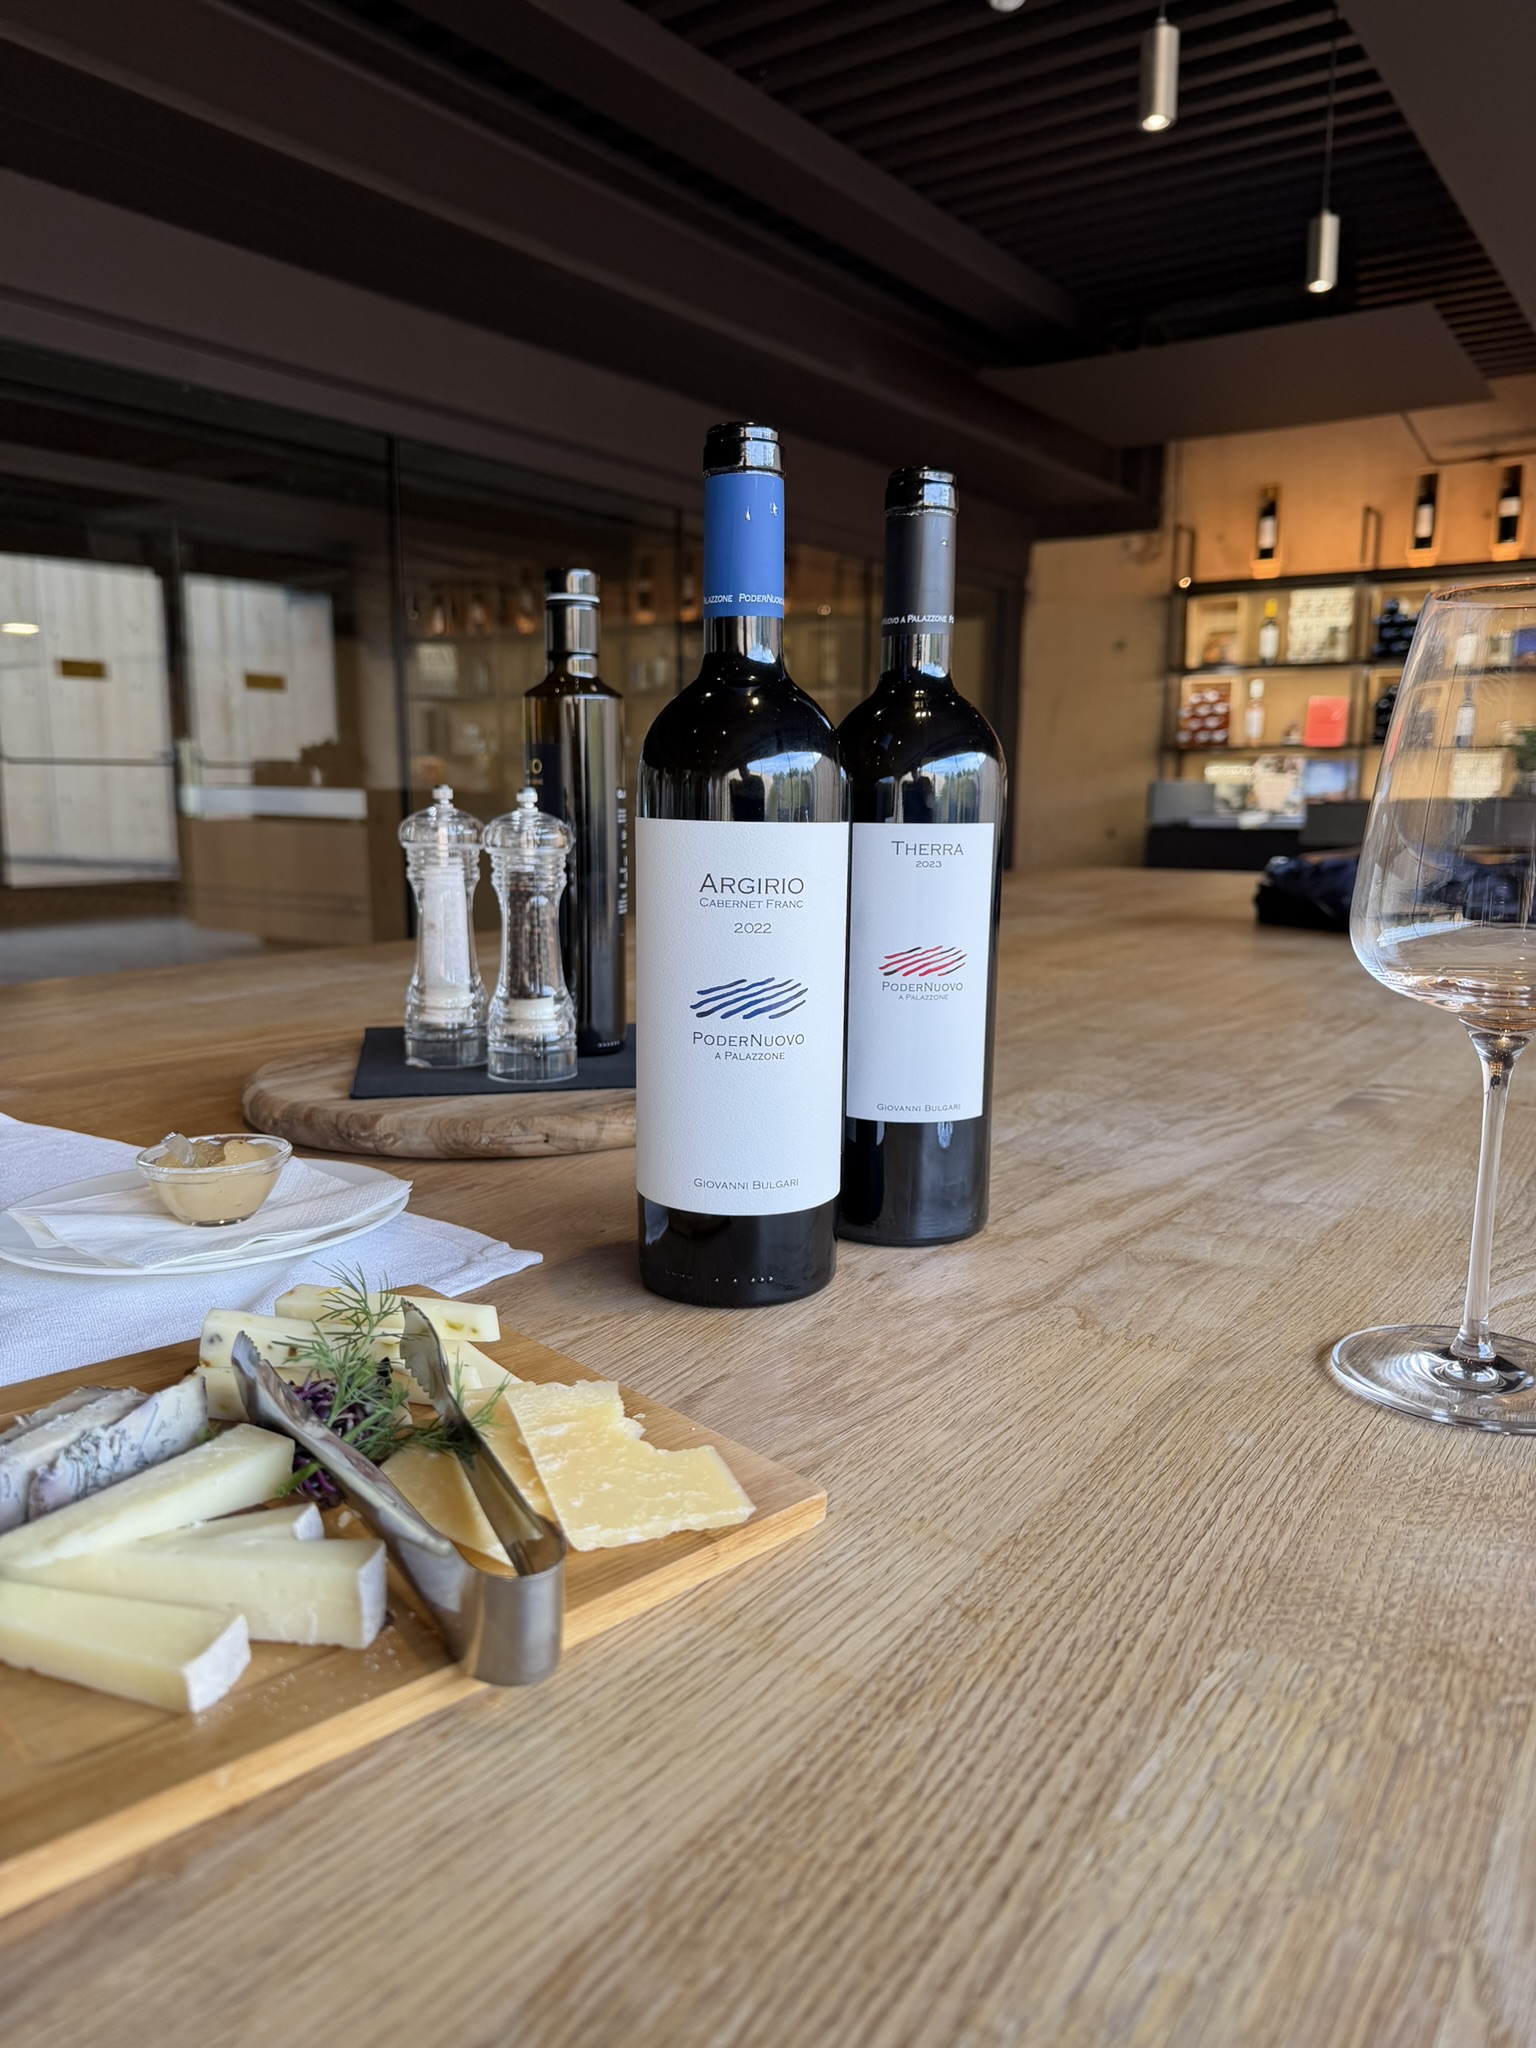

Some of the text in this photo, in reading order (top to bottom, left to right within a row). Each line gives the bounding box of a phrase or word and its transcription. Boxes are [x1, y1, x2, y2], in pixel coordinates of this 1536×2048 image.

[907, 614, 947, 624] PALAZZONE
[891, 840, 964, 856] THERRA
[915, 860, 943, 869] 2023
[699, 873, 804, 895] ARGIRIO
[699, 897, 804, 909] CABERNET FRANC
[734, 922, 772, 934] 2022
[881, 980, 963, 992] PODERNUOVO
[905, 993, 948, 1001] PALAZZONE
[692, 1031, 805, 1047] PODERNUOVO
[714, 1051, 785, 1061] A PALAZZONE
[876, 1103, 961, 1112] GIOVANNI BULGARI
[693, 1177, 799, 1190] GIOVANNI BULGARI
